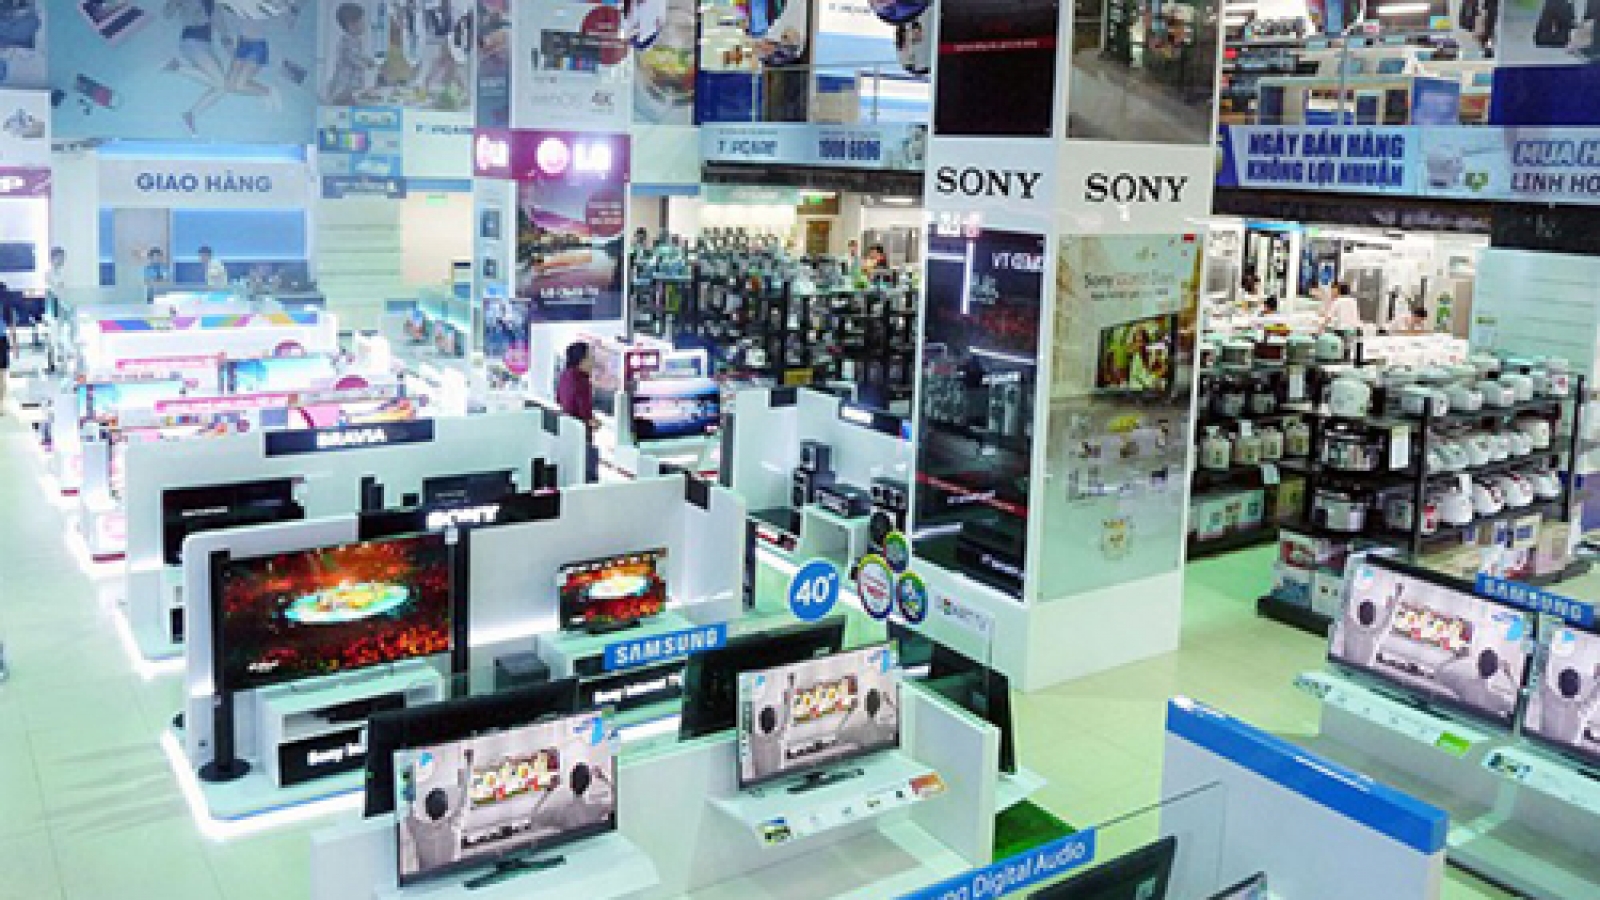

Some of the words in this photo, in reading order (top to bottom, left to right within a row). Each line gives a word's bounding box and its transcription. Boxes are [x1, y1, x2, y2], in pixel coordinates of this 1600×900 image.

[1302, 129, 1343, 157] BÁN
[1347, 129, 1405, 159] HÀNG
[136, 172, 199, 194] GIAO
[204, 168, 273, 195] HÀNG
[936, 165, 1043, 200] SONY
[1084, 172, 1189, 203] SONY
[1511, 172, 1564, 194] LINH
[1483, 579, 1582, 620] SAMSUNG
[614, 628, 718, 666] SAMSUNG
[971, 858, 1032, 898] Digital
[1033, 841, 1087, 875] Audio
